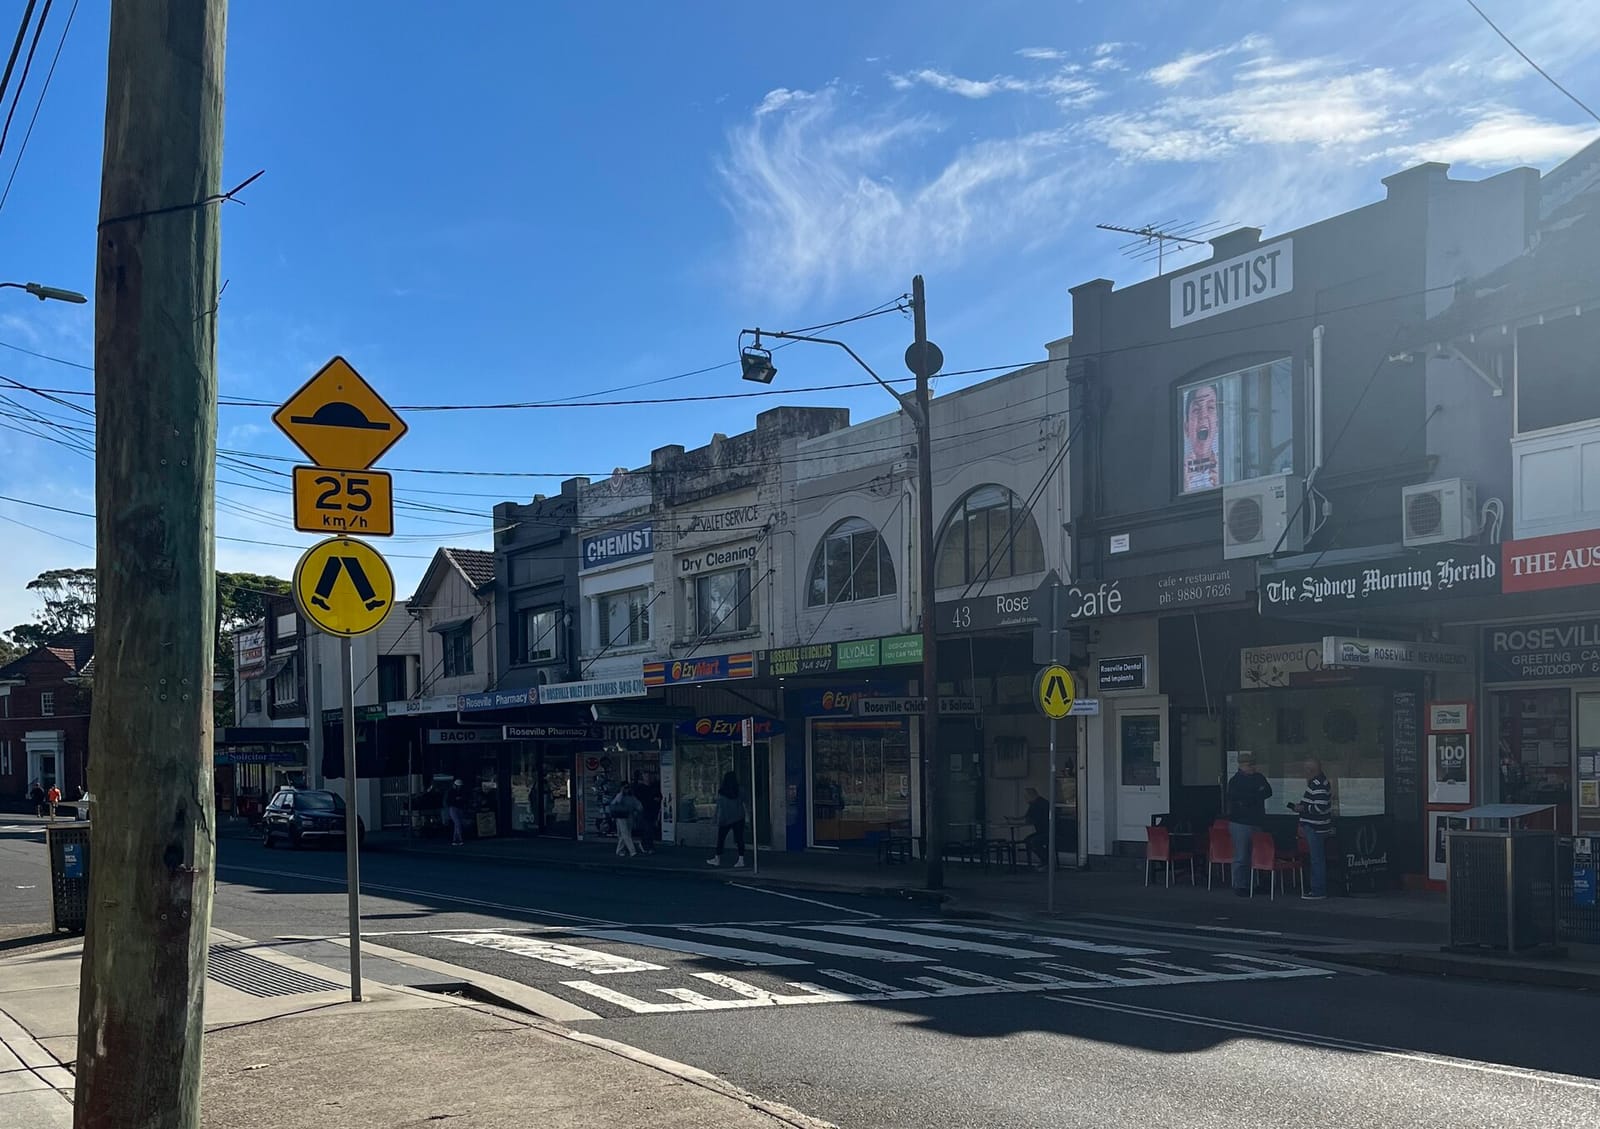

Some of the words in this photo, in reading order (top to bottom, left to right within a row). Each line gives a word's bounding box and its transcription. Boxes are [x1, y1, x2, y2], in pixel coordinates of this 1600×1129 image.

[1183, 249, 1281, 317] DENTIST
[314, 476, 372, 512] 25
[323, 514, 368, 528] km/h
[700, 512, 724, 531] VALET
[724, 505, 759, 528] SERVICE
[587, 527, 652, 562] CHEMIST
[682, 557, 703, 572] Dry
[706, 545, 757, 567] Cleaning
[1510, 552, 1558, 577] THE
[1158, 577, 1177, 589] cafe
[1184, 570, 1232, 584] restaurant
[1267, 578, 1296, 605] The
[1298, 576, 1357, 604] Sydney
[1361, 566, 1433, 598] Morning
[1435, 553, 1497, 591] Herald
[1177, 586, 1203, 602] 9880
[1205, 583, 1232, 598] 7626
[952, 606, 972, 628] 43
[996, 595, 1031, 614] Rose
[1068, 579, 1123, 619] Café
[839, 643, 875, 660] LILYDALE
[1245, 648, 1304, 666] Rosewood
[1342, 653, 1370, 664] Lotteries
[1374, 647, 1414, 663] ROSEVILLE
[1512, 651, 1571, 665] GREETING
[681, 660, 720, 678] EzyMart
[776, 662, 799, 676] SALADS
[1100, 664, 1123, 673] Roseville
[1123, 662, 1142, 671] Dental
[1522, 663, 1585, 677] PHOTOCOPY
[465, 697, 492, 708] Roseville
[495, 692, 528, 706] Pharmacy
[864, 702, 902, 713] Roseville
[440, 731, 476, 742] BACIO
[509, 727, 546, 736] Roseville
[547, 727, 588, 738] Pharmacy
[228, 752, 268, 762] Solicitor
[1438, 744, 1465, 761] 100
